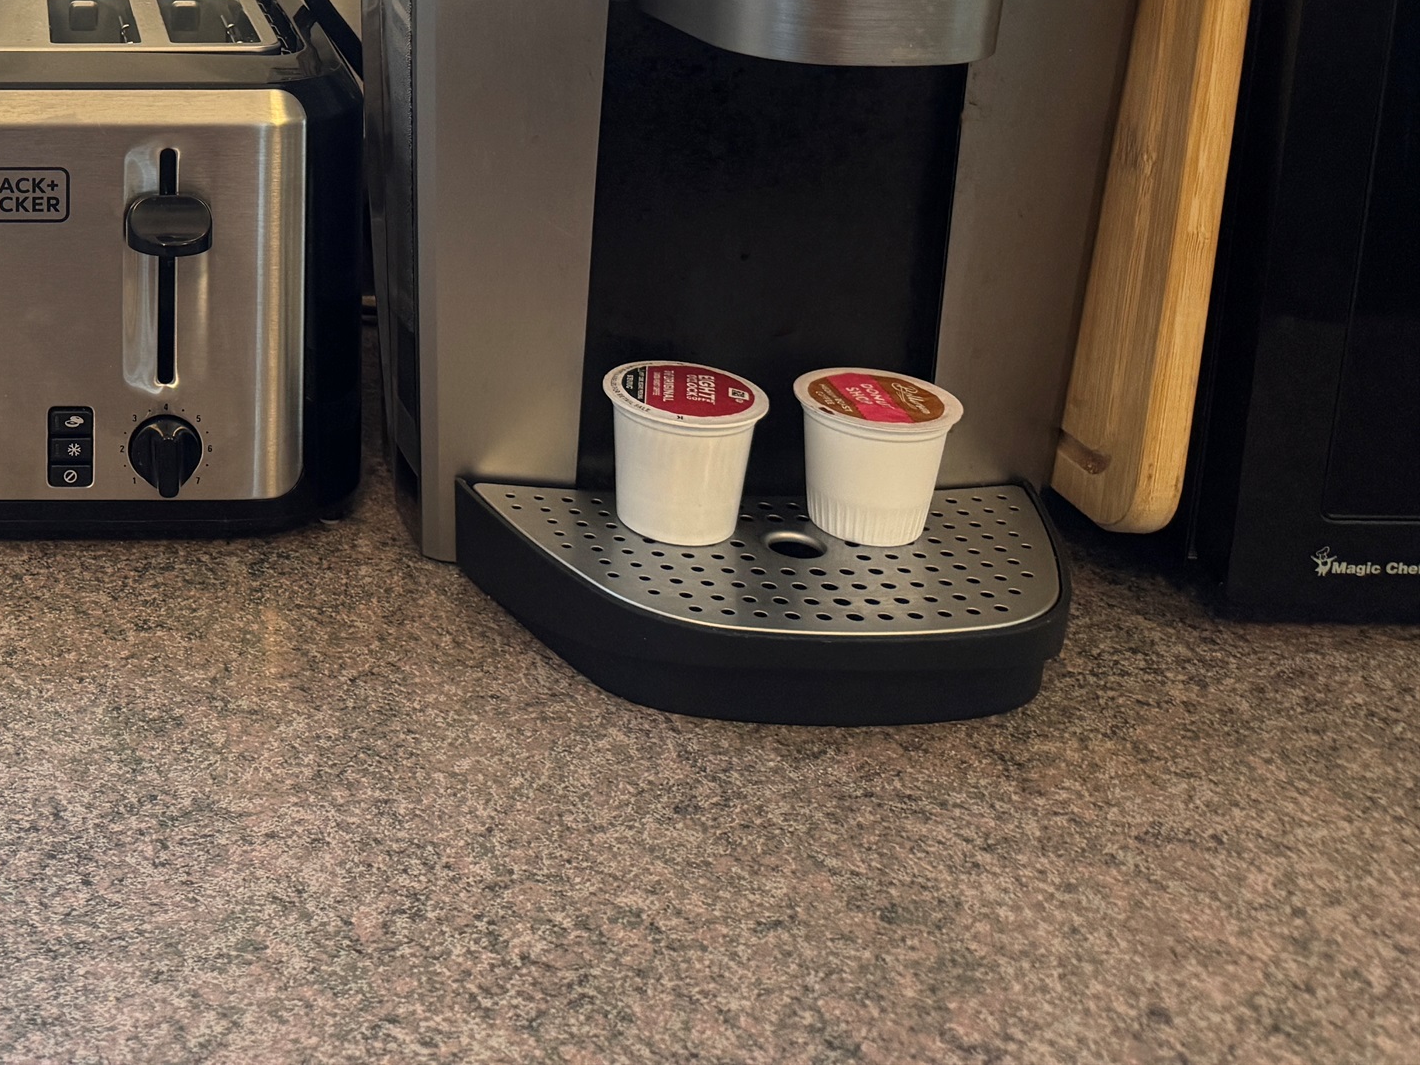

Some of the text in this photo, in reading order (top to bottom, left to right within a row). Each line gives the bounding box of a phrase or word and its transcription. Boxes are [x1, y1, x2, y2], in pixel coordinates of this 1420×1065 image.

[698, 374, 716, 405] EIGHT
[846, 387, 874, 405] SHOP
[860, 383, 896, 410] DONUT
[163, 403, 169, 411] 4
[132, 414, 137, 422] 3
[132, 476, 136, 484] 1
[195, 476, 200, 484] 7
[1331, 561, 1420, 576] Magic Che
